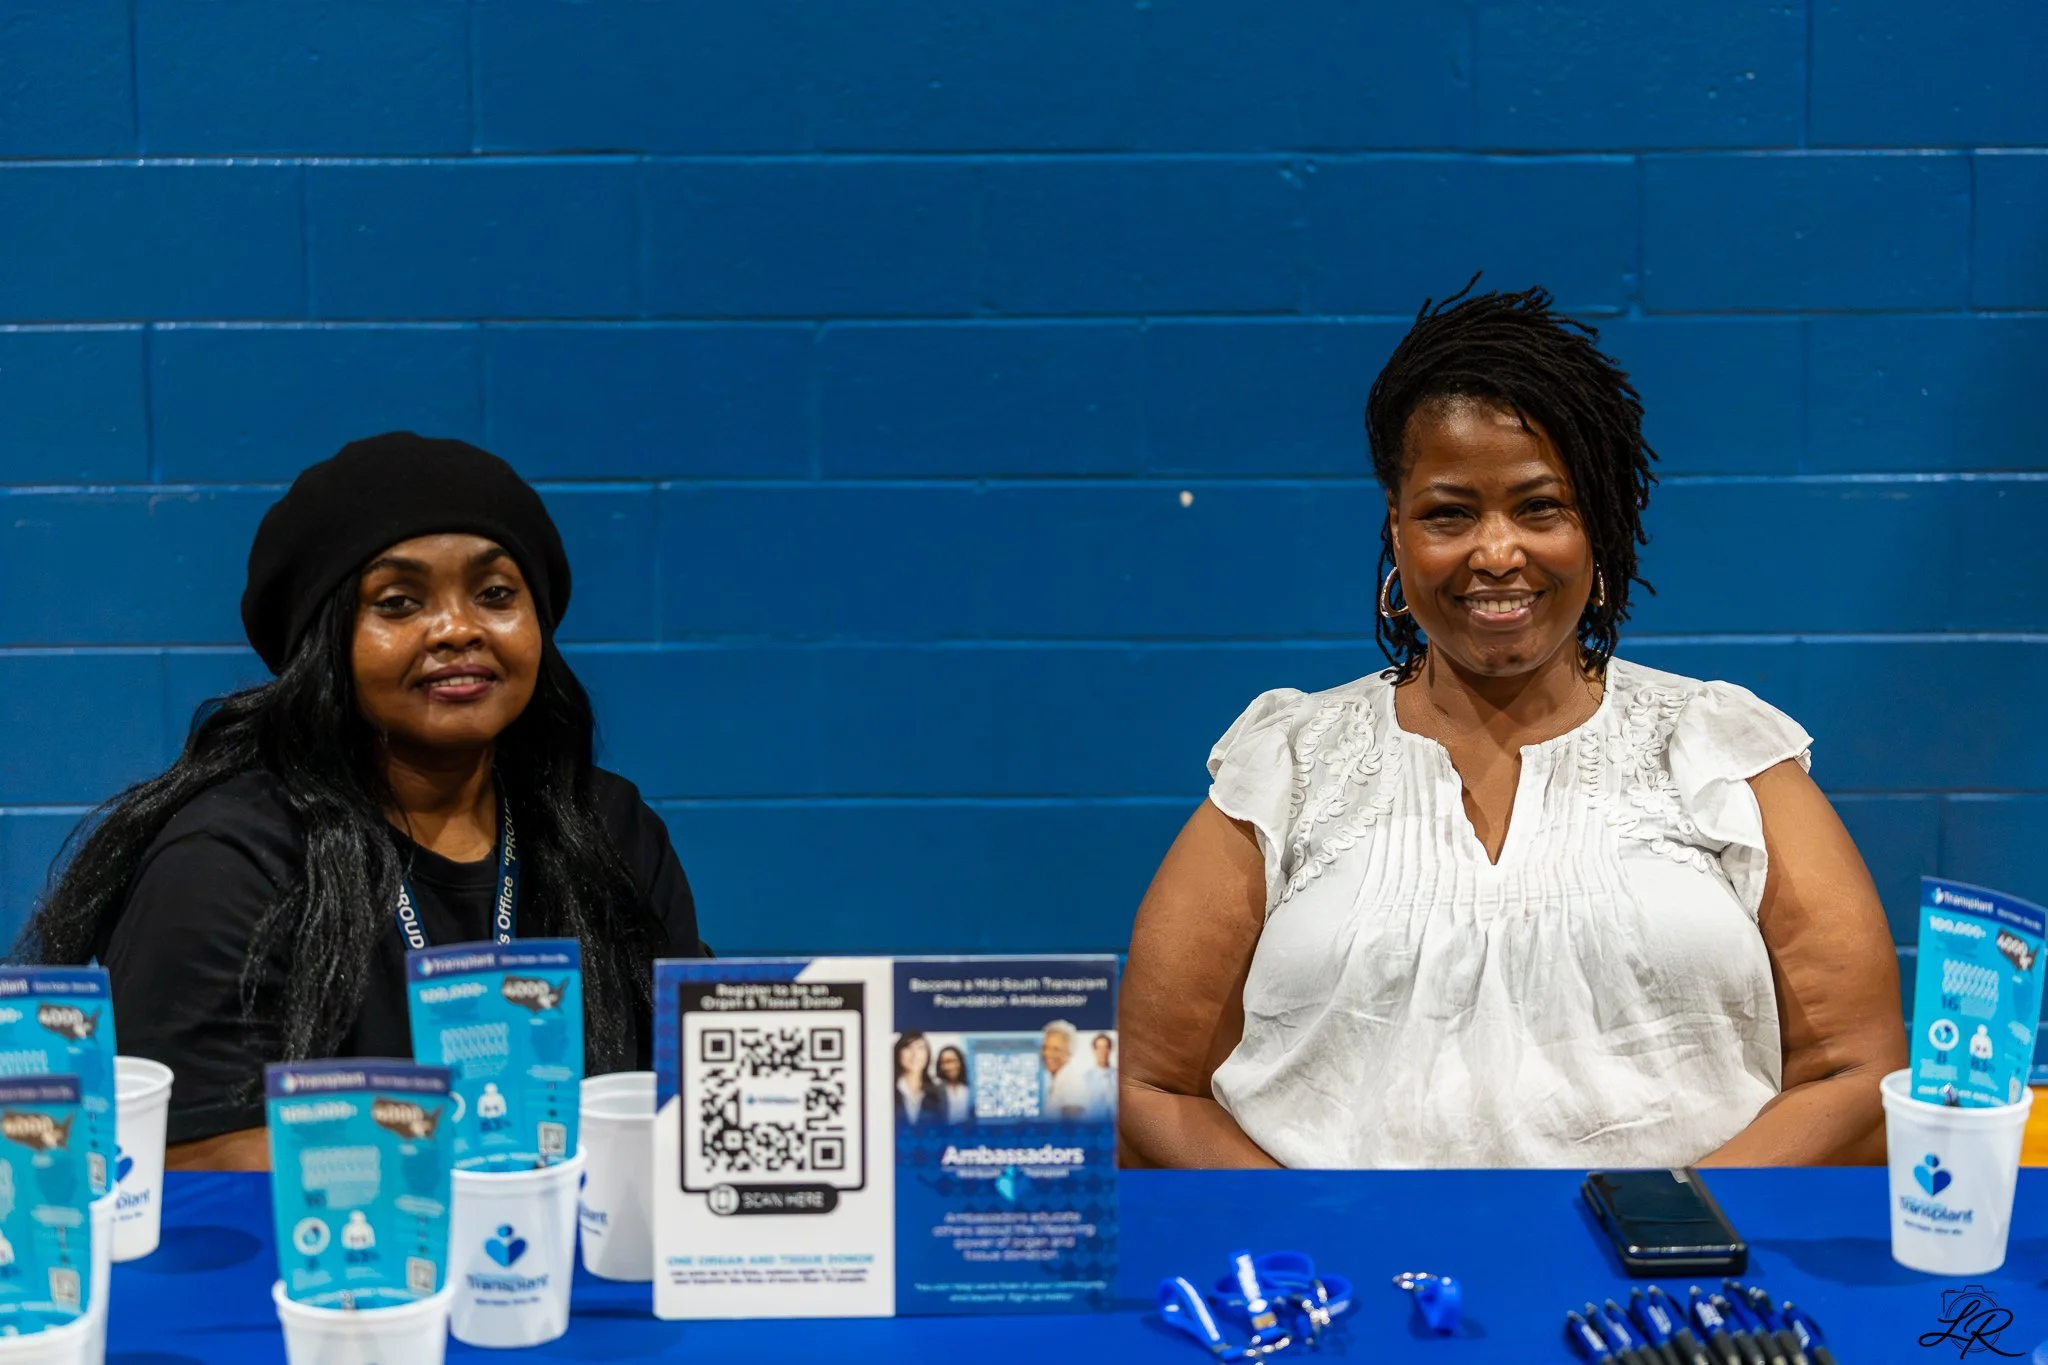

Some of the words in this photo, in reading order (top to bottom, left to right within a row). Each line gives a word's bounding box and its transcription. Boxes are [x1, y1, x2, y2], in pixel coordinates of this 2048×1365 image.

[497, 875, 514, 930] Office
[715, 983, 772, 999] Register
[772, 984, 789, 997] to
[789, 983, 809, 997] be
[909, 977, 962, 992] Become
[1041, 976, 1108, 992] Transplant
[701, 995, 744, 1011] Organ
[758, 995, 799, 1009] Tissue
[800, 994, 844, 1009] Donor
[933, 993, 1007, 1008] Foundation
[1009, 993, 1088, 1008] Ambassador
[941, 1144, 1085, 1165] Ambassadors
[742, 1191, 784, 1209] SCAN
[784, 1190, 826, 1208] HERE
[1899, 1195, 1975, 1224] Transplant
